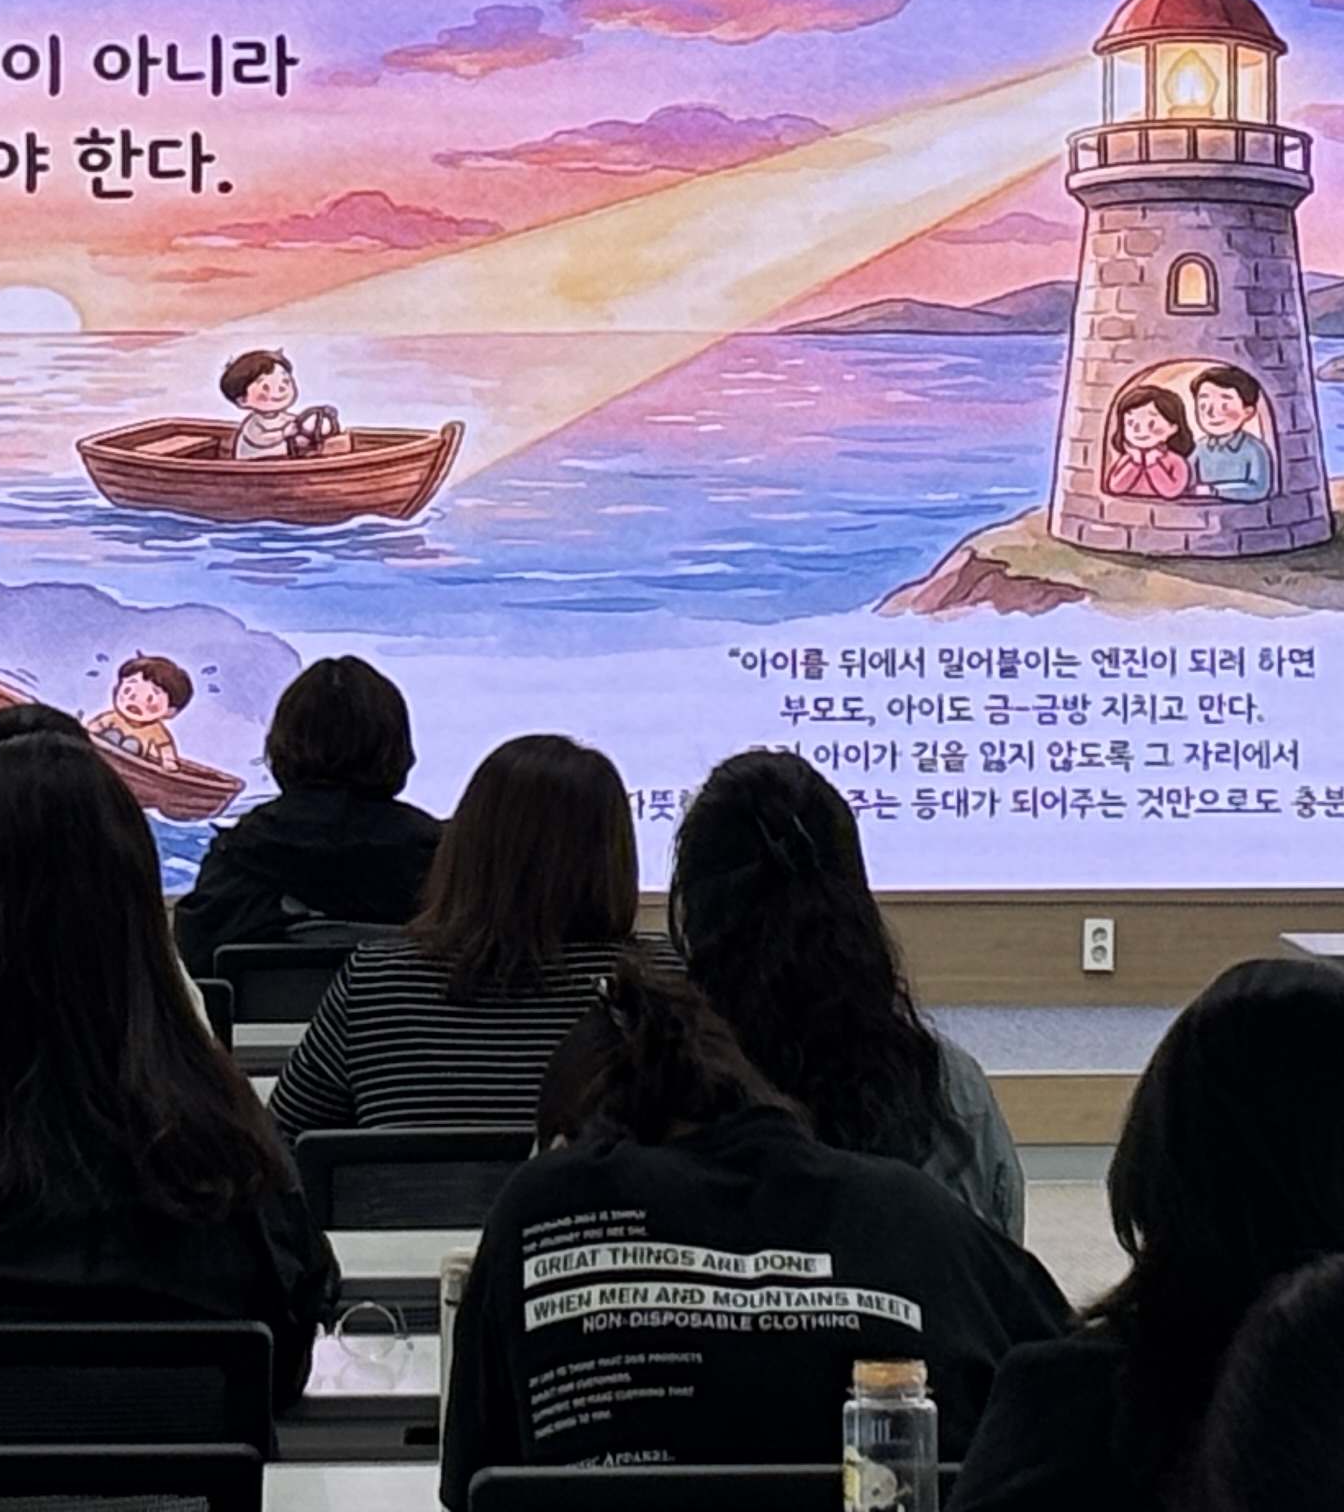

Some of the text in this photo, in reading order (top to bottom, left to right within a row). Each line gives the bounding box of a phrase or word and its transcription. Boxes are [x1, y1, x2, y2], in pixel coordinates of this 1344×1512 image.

[94, 32, 299, 100] 아니라
[75, 126, 235, 200] 한다.
[838, 647, 925, 679] 뒤에서
[938, 646, 1078, 679] 밀어붙이는
[1091, 646, 1177, 678] 엔진이
[1258, 646, 1316, 678] 하면
[780, 695, 876, 726] 부모도,
[887, 693, 974, 725] 아이도
[1101, 693, 1188, 724] 지치고
[1199, 693, 1265, 724] 만다.
[814, 741, 901, 771] 아이가
[911, 741, 967, 771] 길을
[979, 741, 1034, 772] 잃지
[1047, 740, 1134, 772] 않도록
[1144, 741, 1174, 768] 그
[1184, 739, 1299, 770] 자리에서
[911, 786, 1001, 820] 등대가
[1010, 786, 1127, 820] 되어주는
[1137, 786, 1282, 819] 것만으로도
[534, 1248, 601, 1277] GREAT
[610, 1246, 696, 1267] THINGS
[701, 1251, 747, 1273] ARE
[754, 1253, 817, 1273] DONE
[533, 1286, 913, 1321] WHEN MEN AND MOUNTAINS MEET
[582, 1311, 860, 1333] NON-DISPOSABLE CLOTHING
